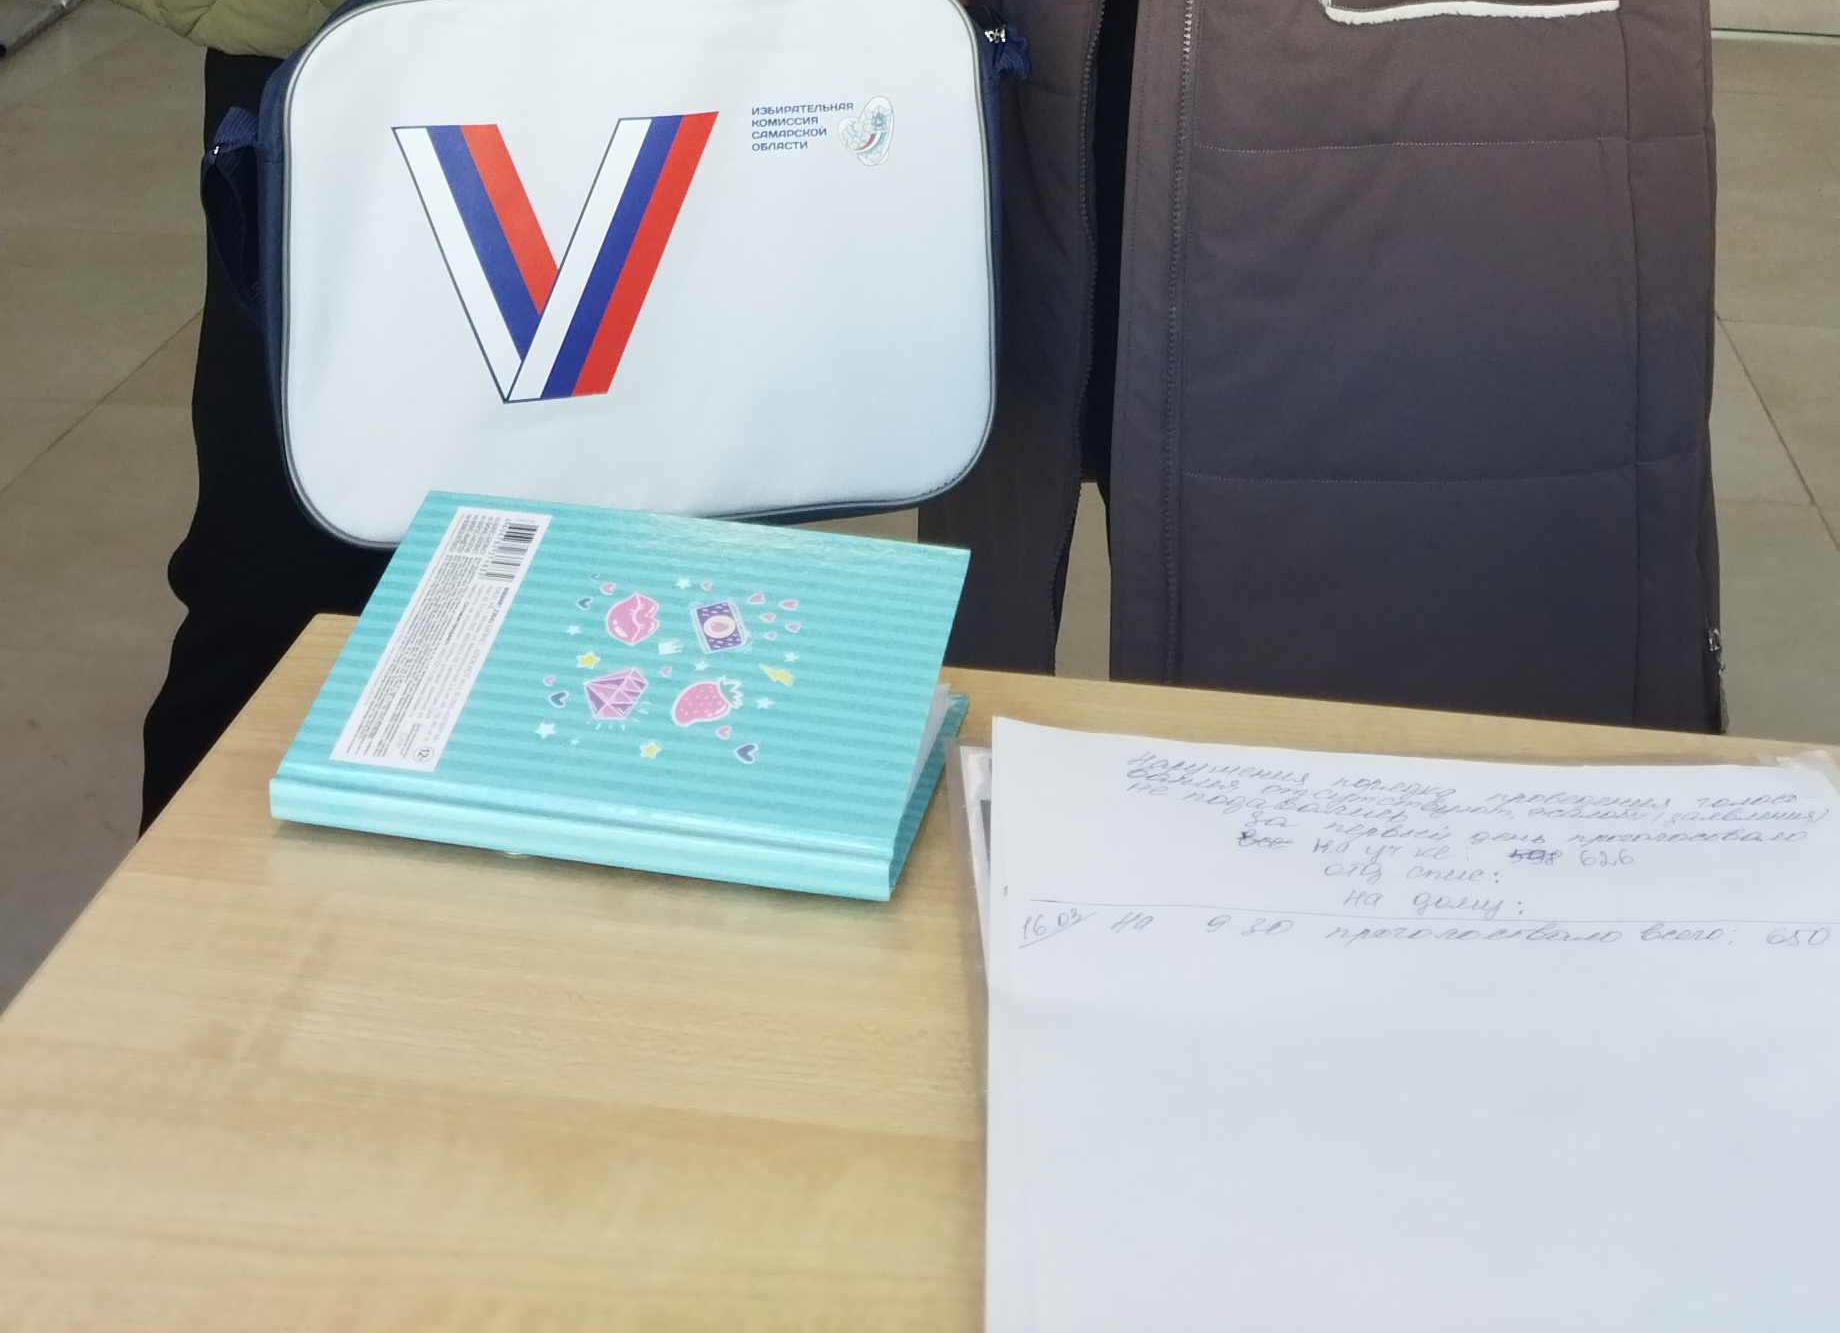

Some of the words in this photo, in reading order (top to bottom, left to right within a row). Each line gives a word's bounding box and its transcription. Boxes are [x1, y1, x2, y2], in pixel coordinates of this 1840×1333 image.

[751, 102, 854, 115] ИЗБИРАТЕЛЬНАЯ
[751, 116, 819, 128] КОМИССИЯ
[751, 126, 827, 140] САМАРСКОЙ
[751, 141, 808, 152] ОБЛАСТИ
[1580, 849, 1634, 867] 626
